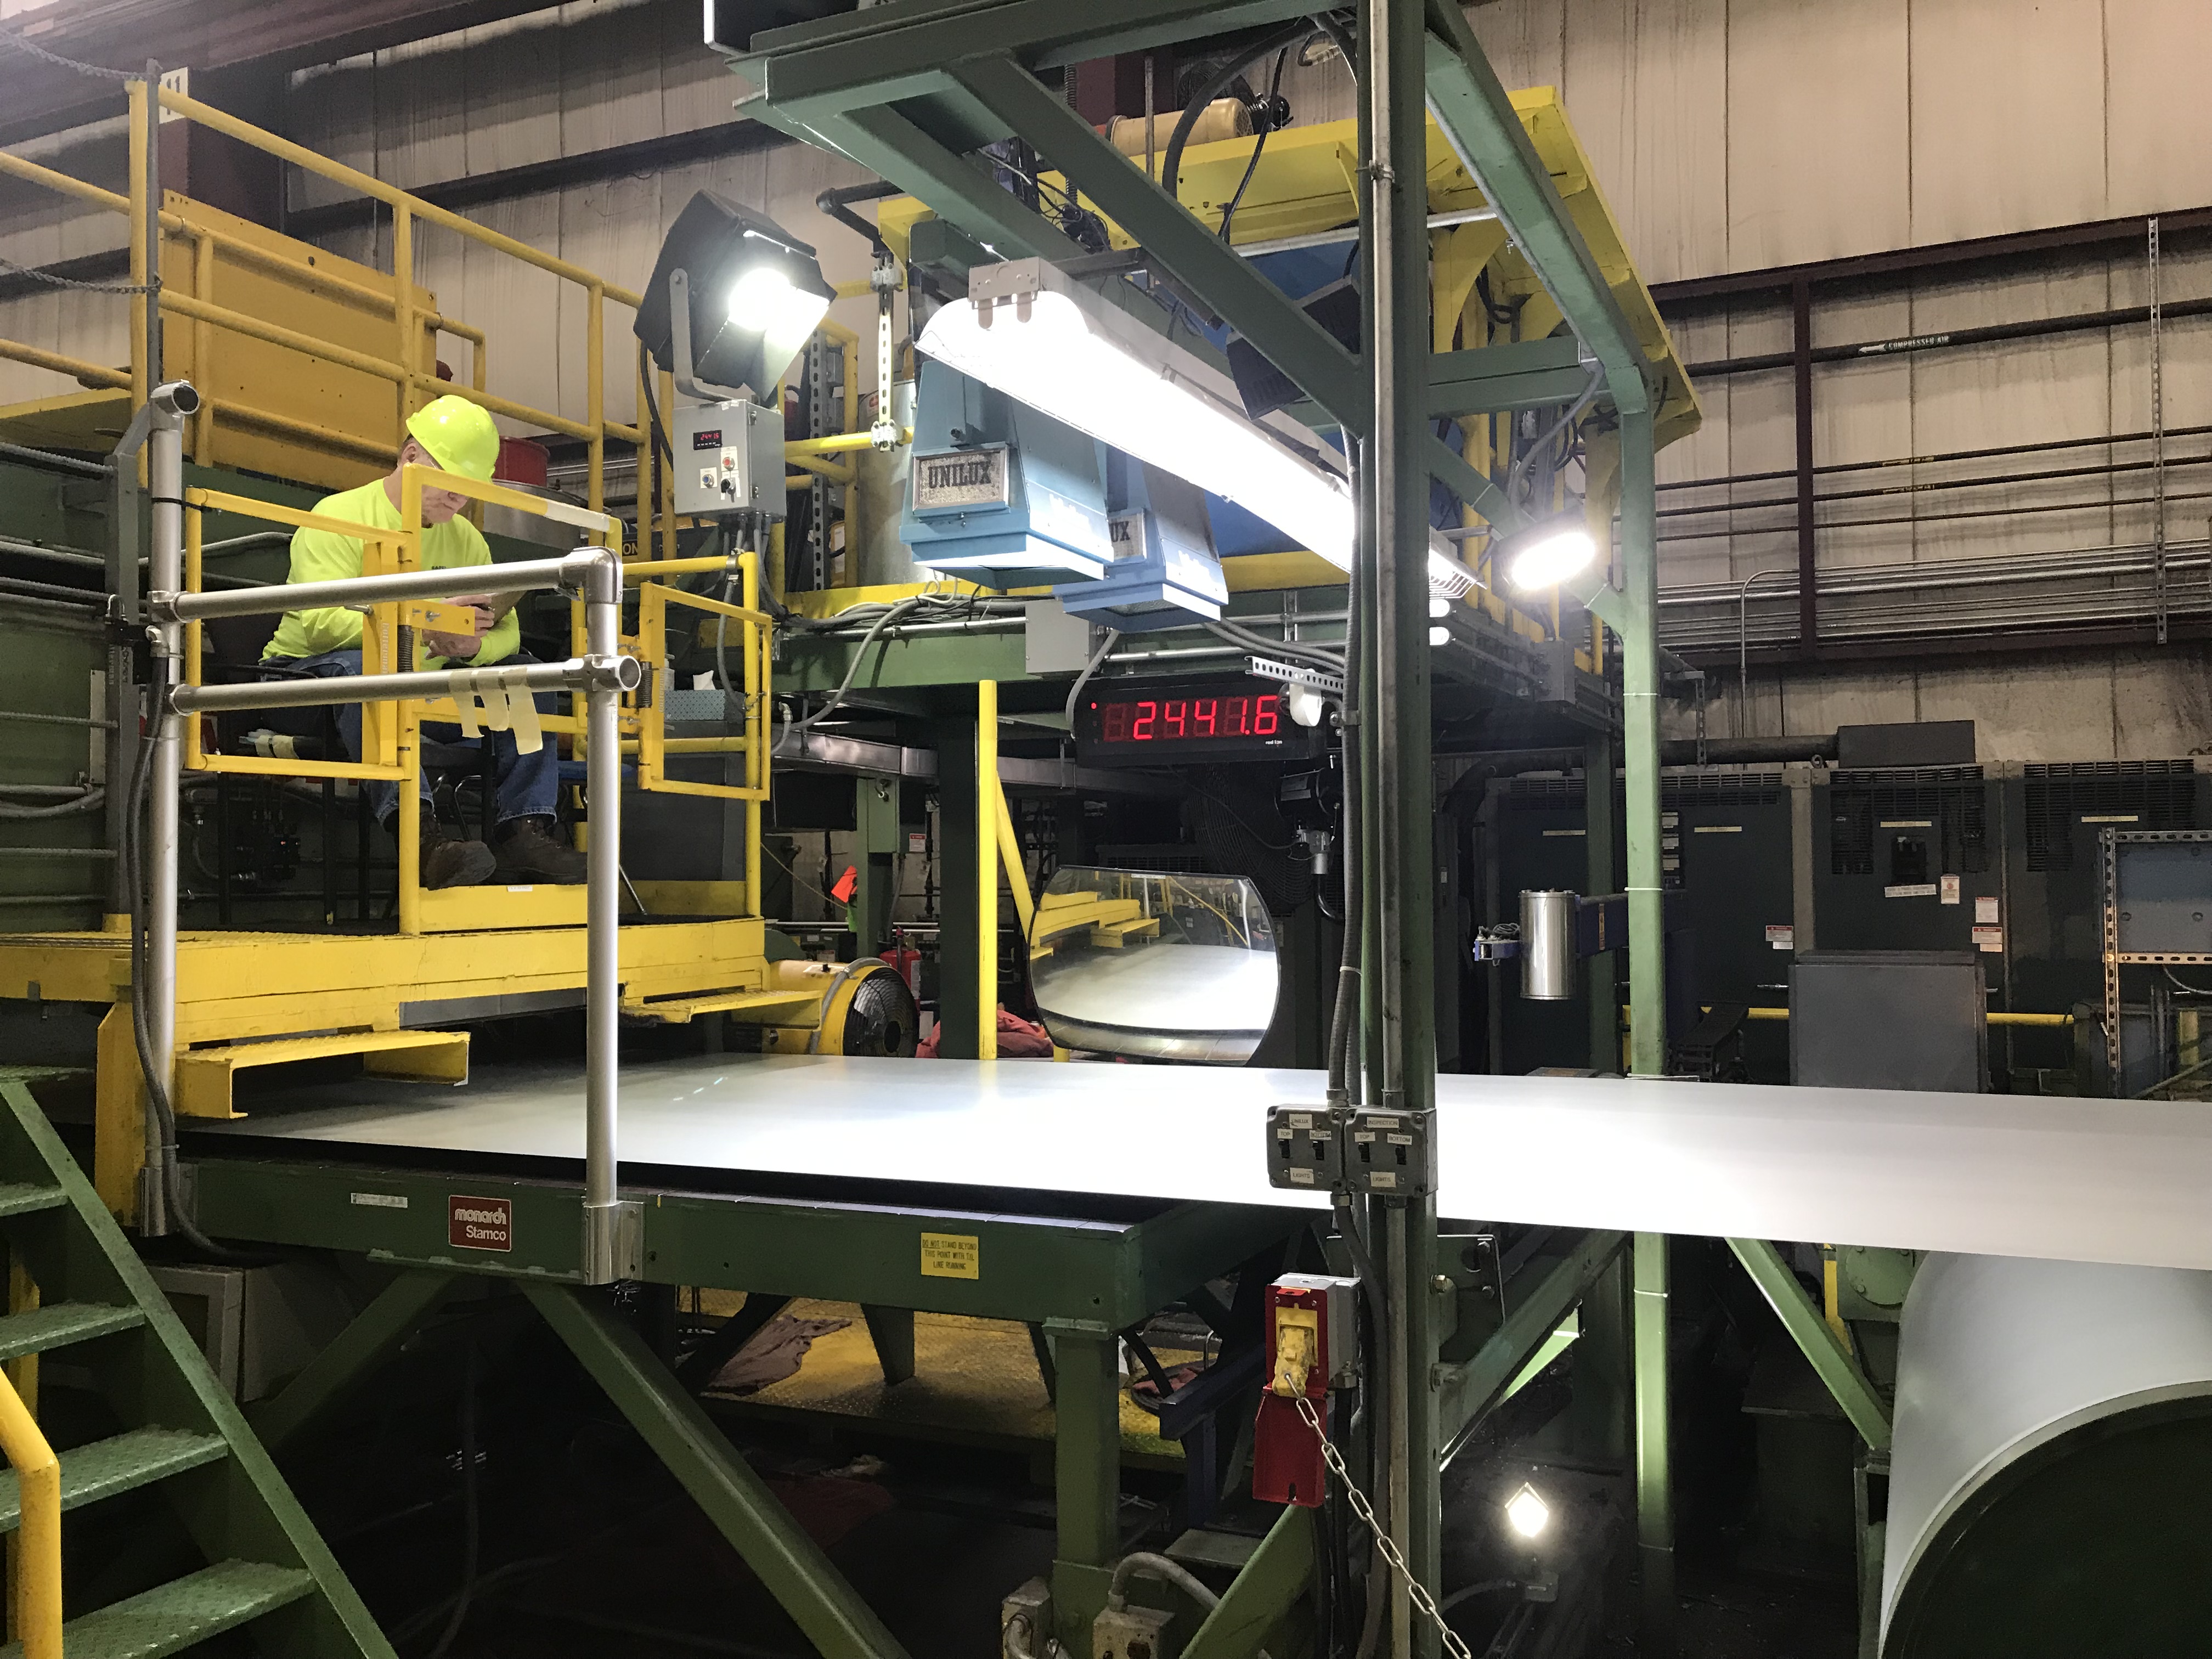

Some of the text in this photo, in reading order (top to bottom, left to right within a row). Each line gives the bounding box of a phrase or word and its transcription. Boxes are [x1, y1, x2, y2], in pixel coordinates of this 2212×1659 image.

[1888, 335, 1949, 350] COMPRESSED AIR
[928, 460, 992, 489] UNILUX
[1133, 695, 1278, 740] 2441.6
[454, 1207, 507, 1225] monarch
[466, 1224, 506, 1242] Stamco
[941, 1240, 957, 1249] STAND
[958, 1242, 977, 1251] BEYOND
[937, 1250, 951, 1259] POINT
[933, 1261, 967, 1270] LINE RUNNING
